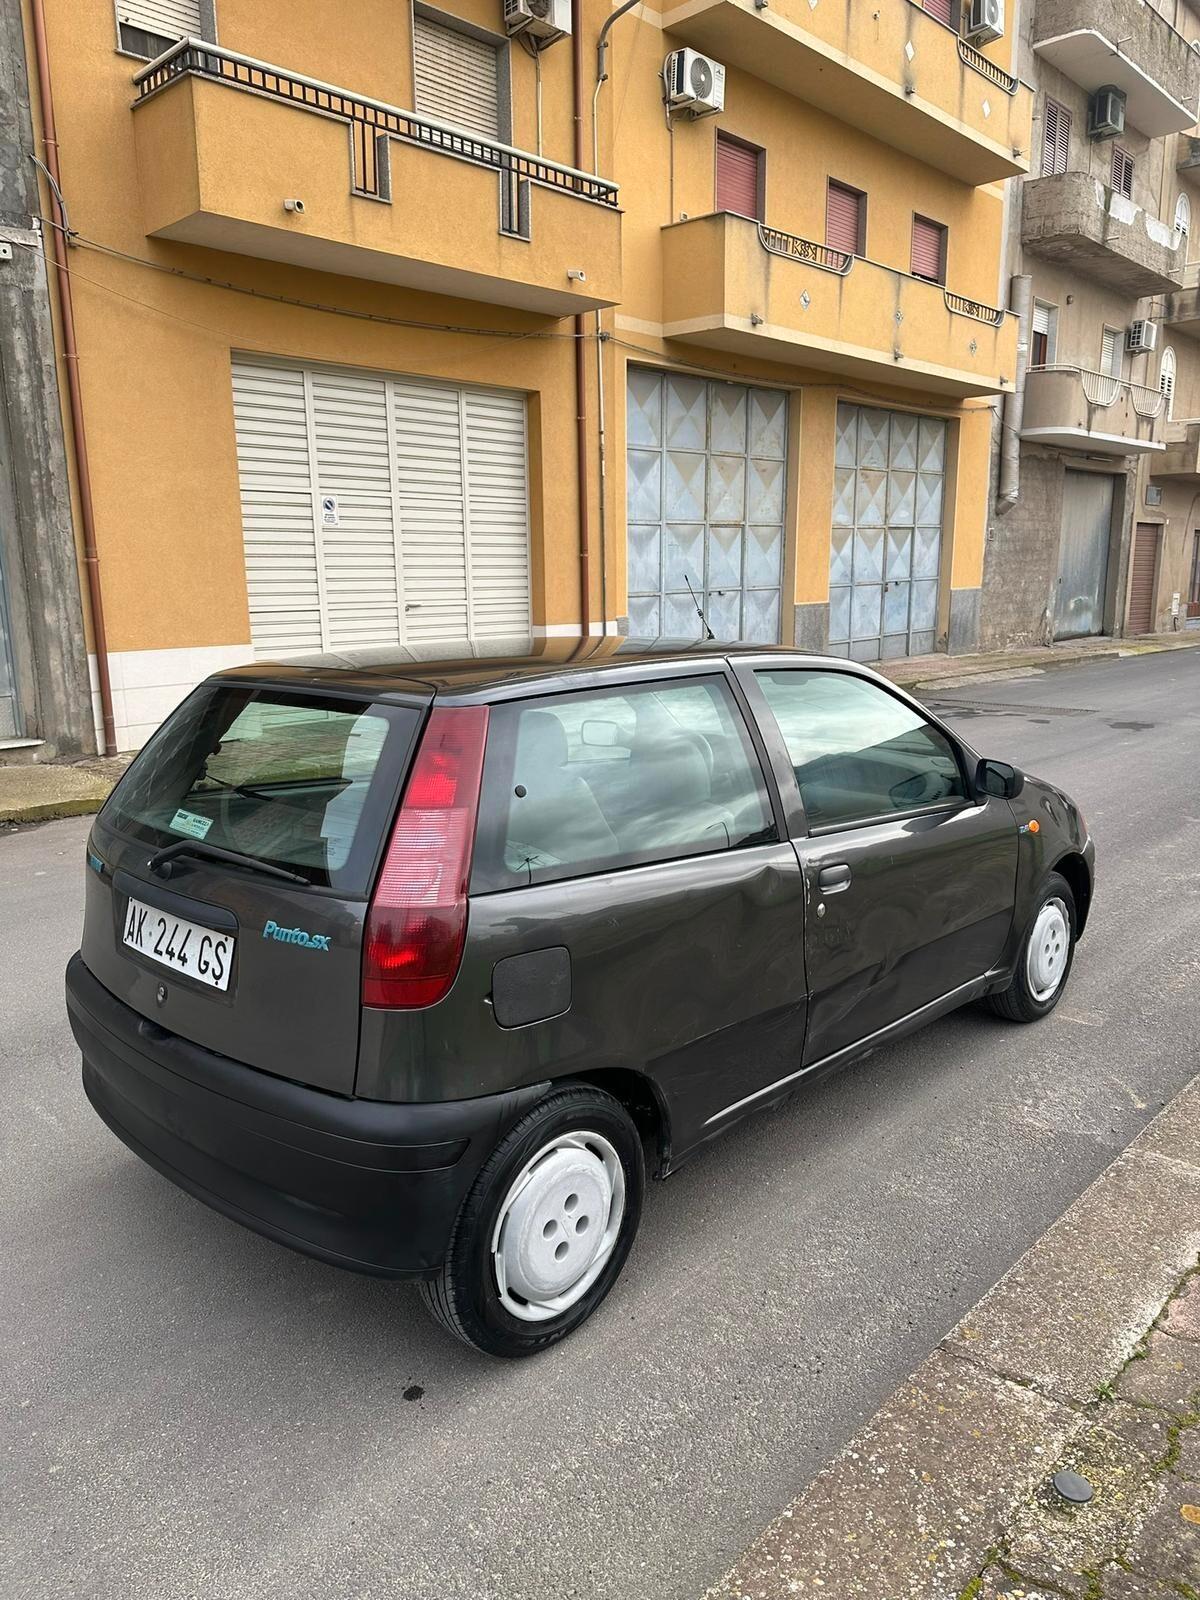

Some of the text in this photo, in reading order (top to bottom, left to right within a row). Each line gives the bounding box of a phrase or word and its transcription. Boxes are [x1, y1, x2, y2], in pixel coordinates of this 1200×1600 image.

[126, 905, 228, 981] AK 244 GS
